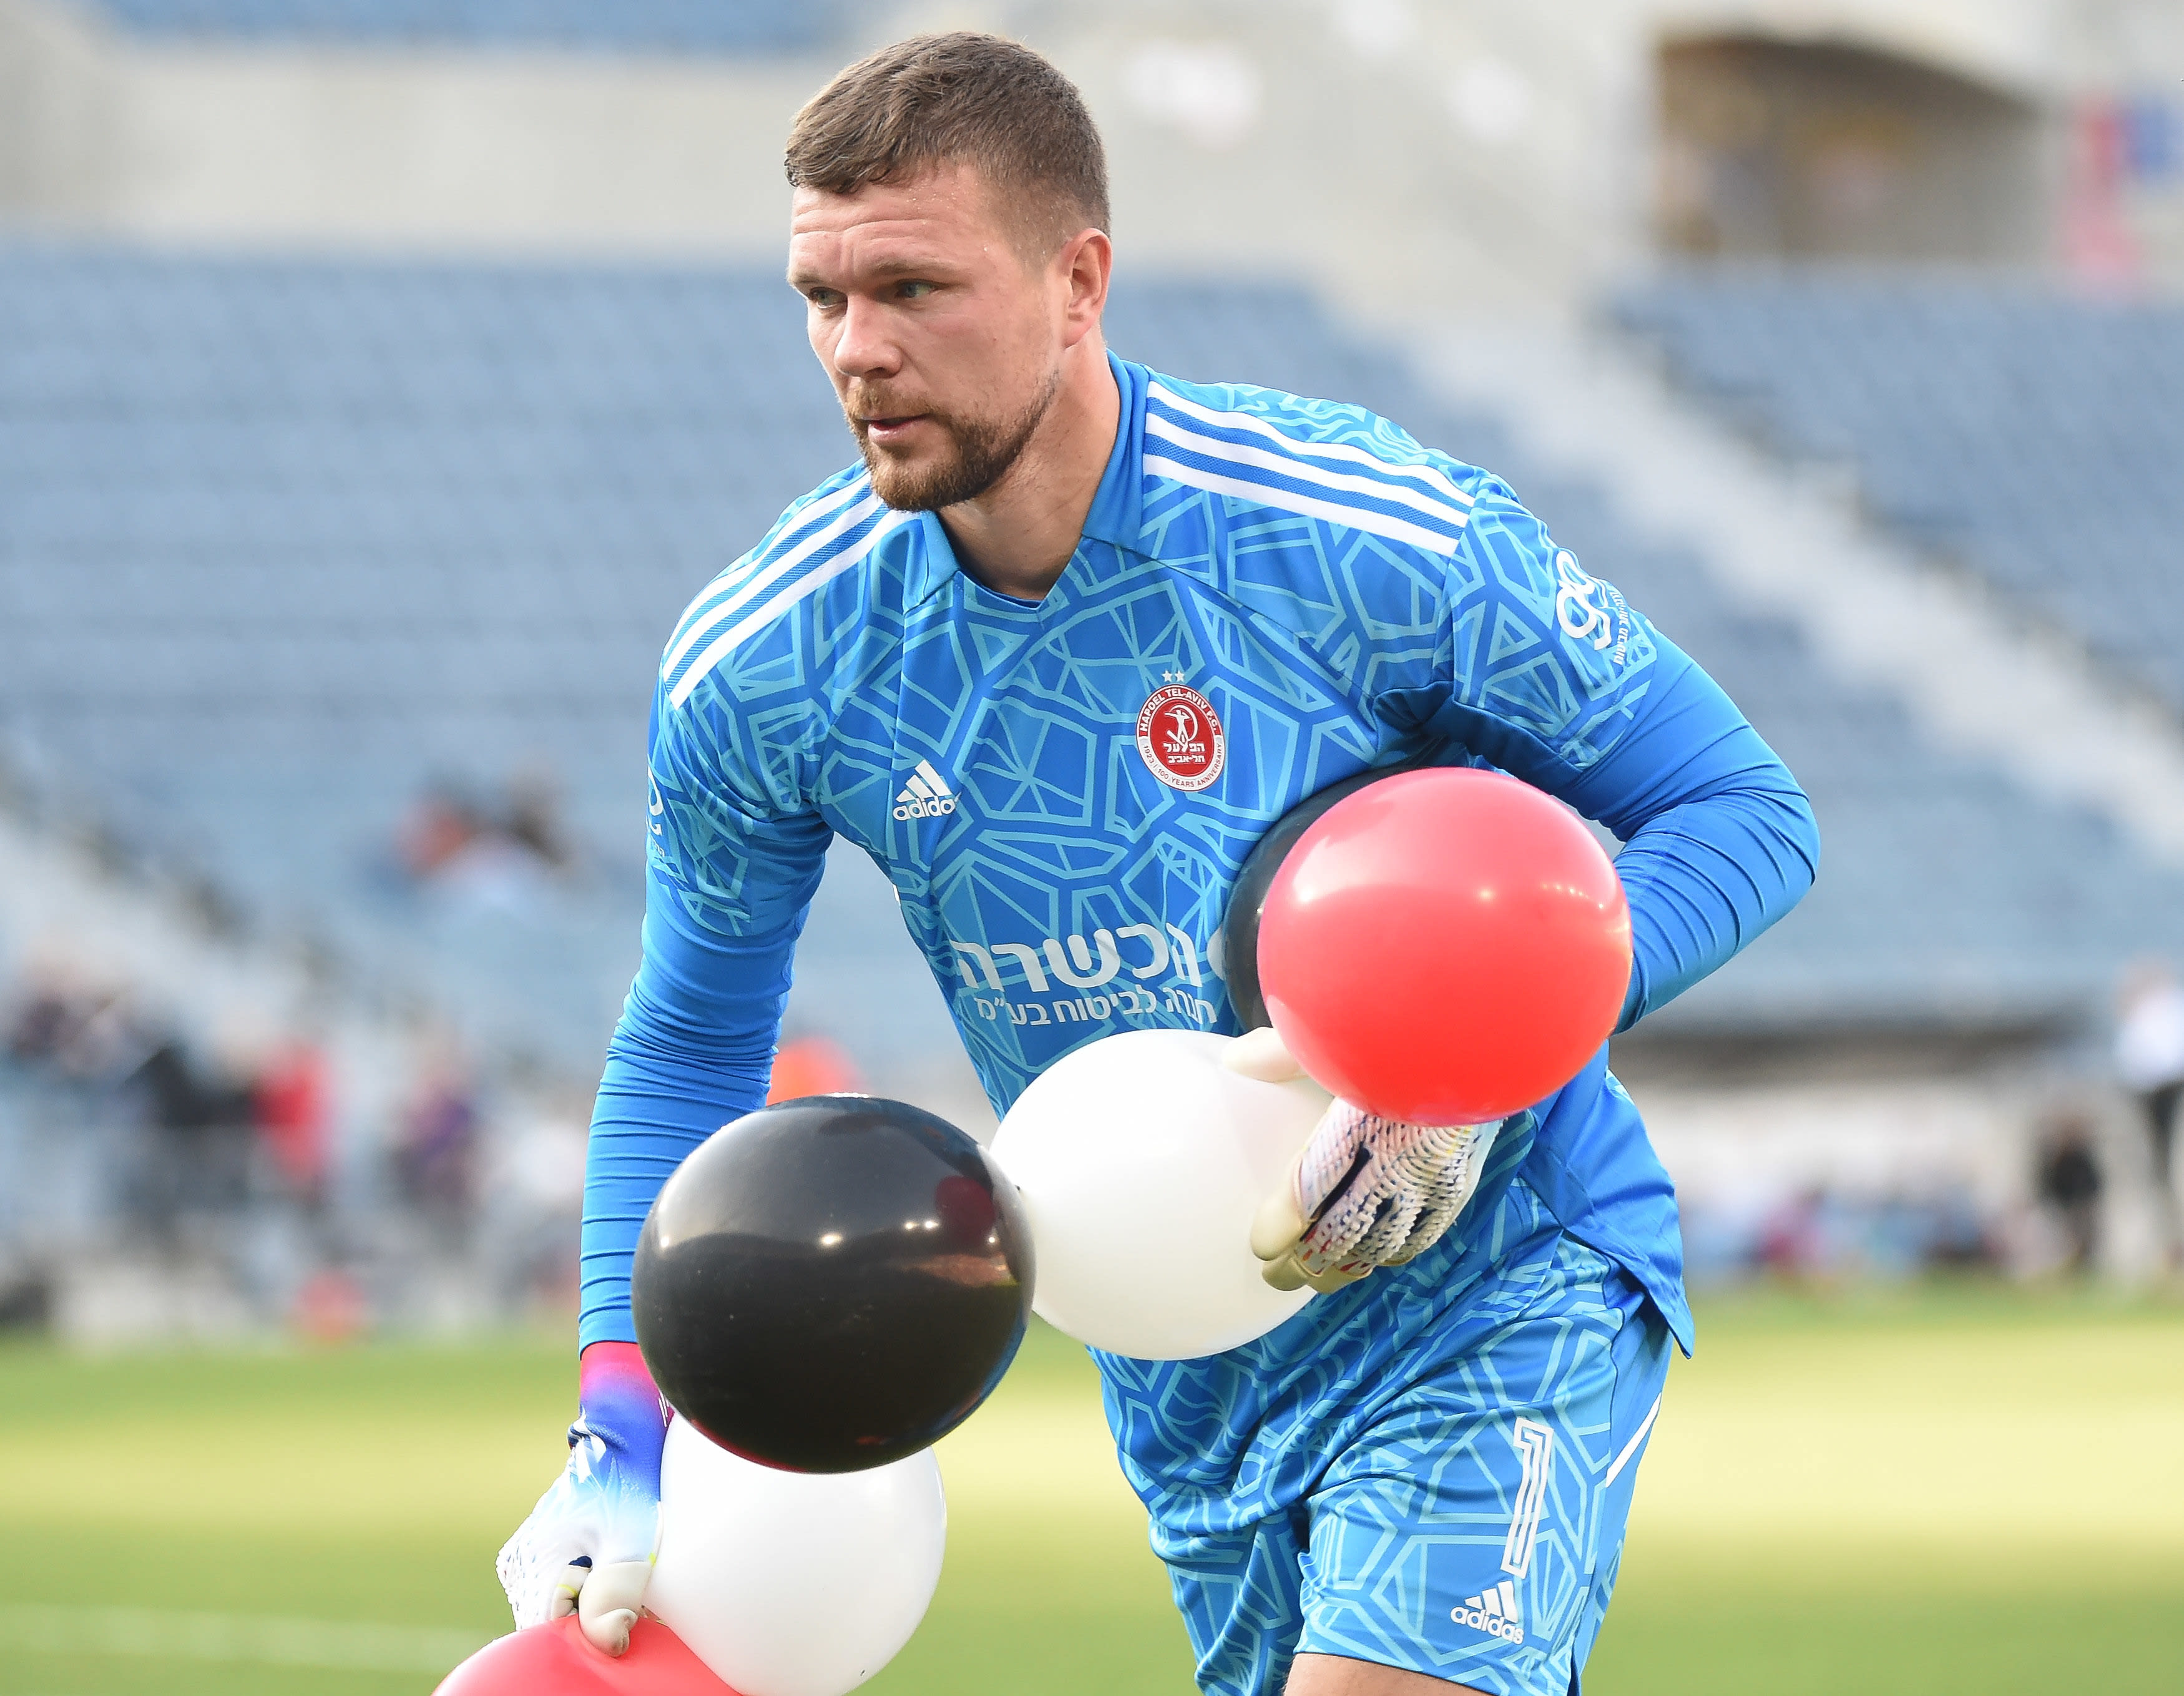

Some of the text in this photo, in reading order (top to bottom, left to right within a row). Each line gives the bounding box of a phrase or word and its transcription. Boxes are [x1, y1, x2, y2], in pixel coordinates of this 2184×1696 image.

[1139, 694, 1165, 732] HAPOEL
[1165, 688, 1208, 708] TEL-AVIV
[1158, 769, 1169, 780] 100
[1172, 777, 1195, 787] YEARS
[1197, 743, 1222, 786] ANNIVERSARY
[1053, 984, 1157, 1021] לביטוח
[1501, 1417, 1554, 1579] 1
[1450, 1606, 1524, 1645] adidas
